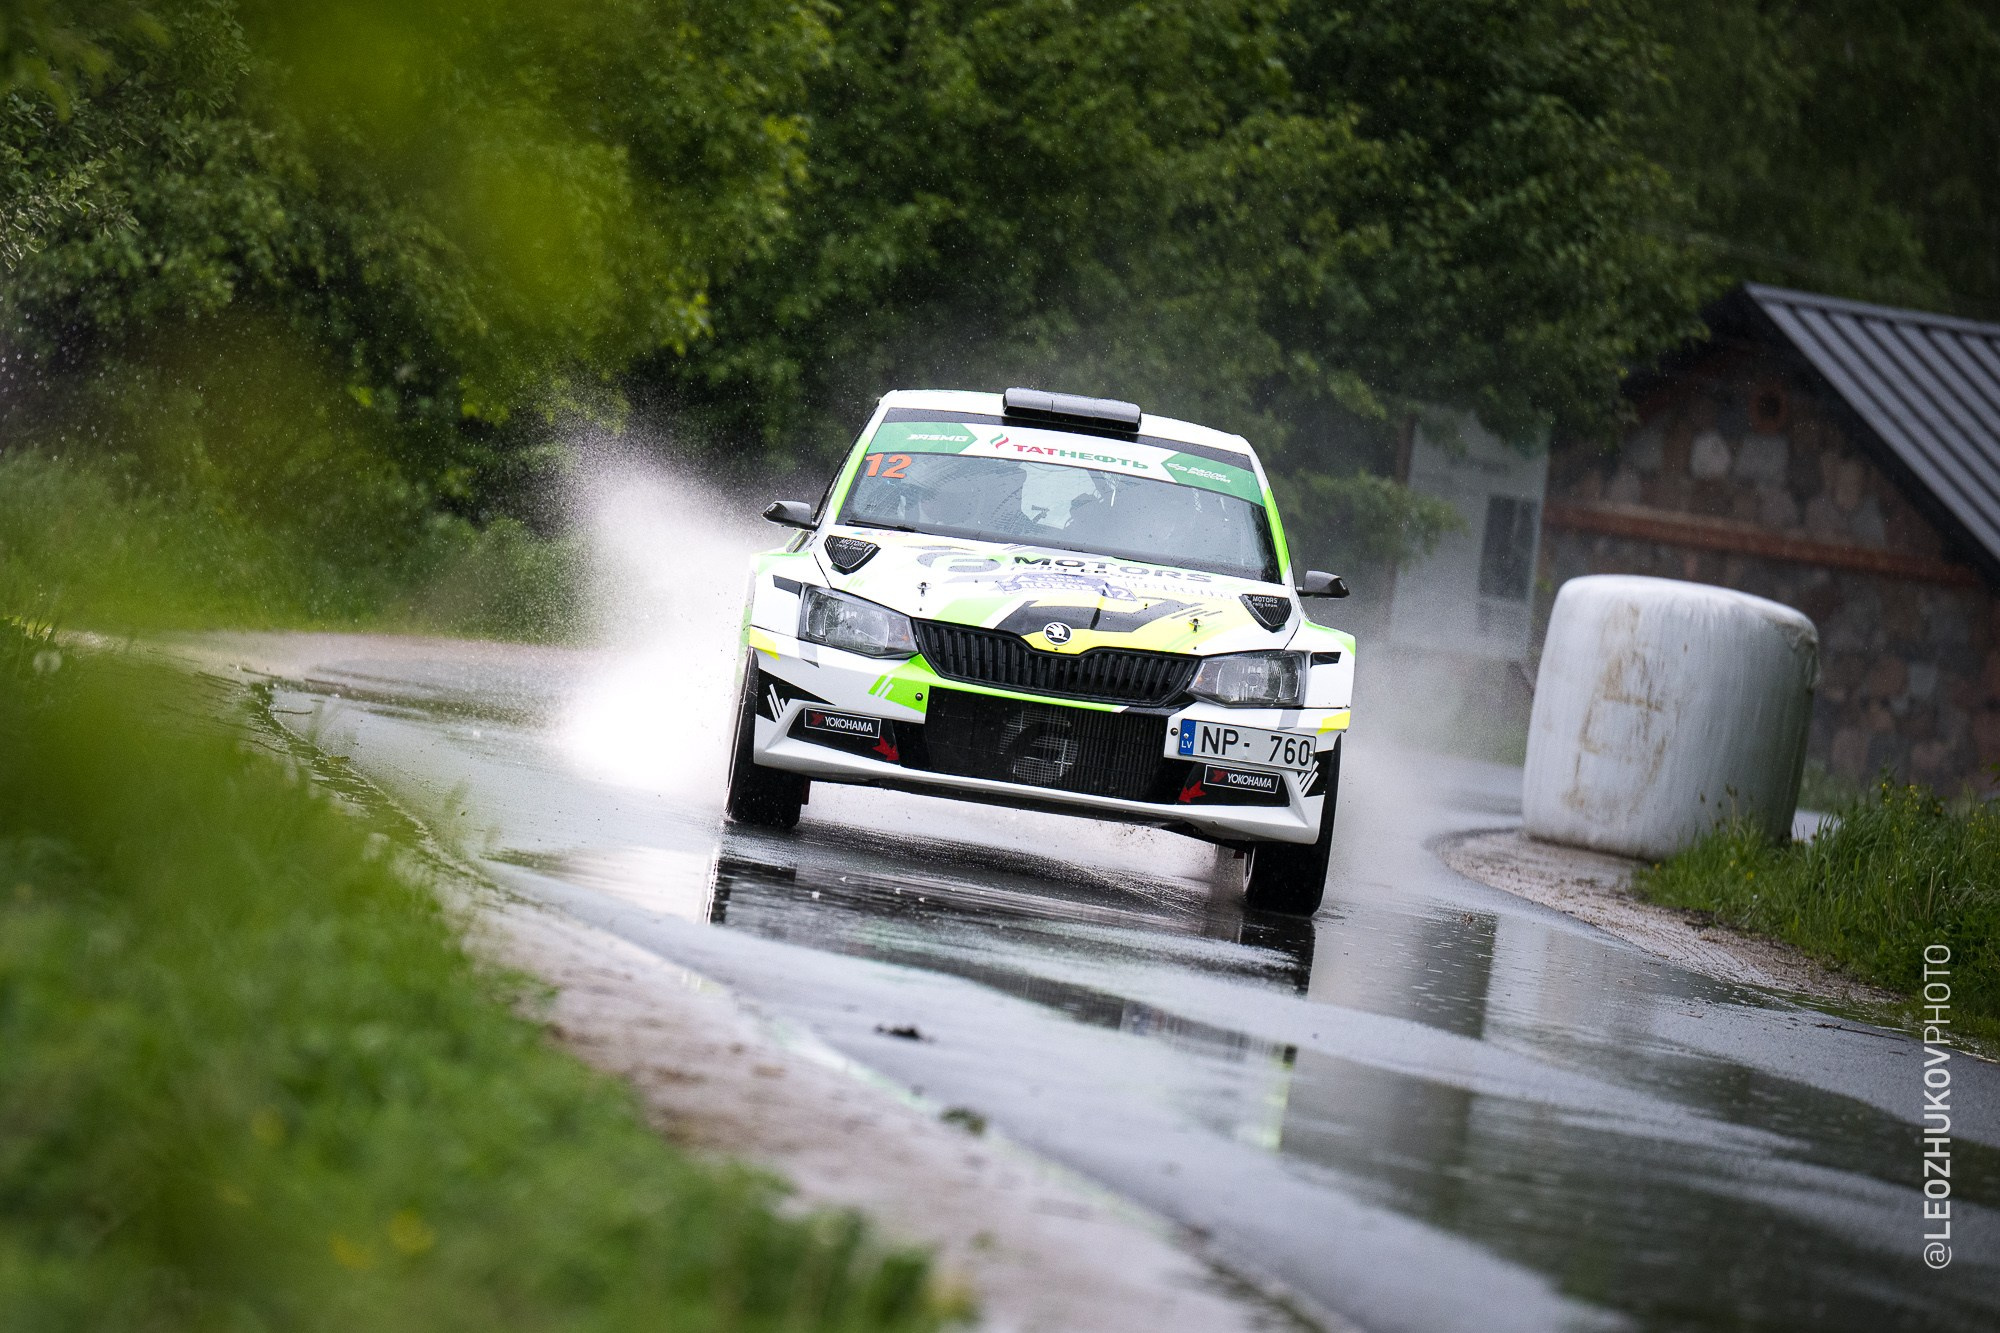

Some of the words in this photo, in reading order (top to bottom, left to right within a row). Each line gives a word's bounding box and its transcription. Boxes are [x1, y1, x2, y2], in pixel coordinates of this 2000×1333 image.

[865, 453, 912, 479] 12
[1012, 444, 1149, 470] ТАТНЕФТЬ
[839, 538, 868, 548] MOTORS
[1014, 556, 1212, 583] MOTORS
[1252, 595, 1278, 604] MOTORS
[824, 715, 873, 733] YOKOHAMA
[1181, 740, 1193, 749] LV
[1268, 734, 1311, 767] 760
[1227, 772, 1272, 789] YOKOHAMA
